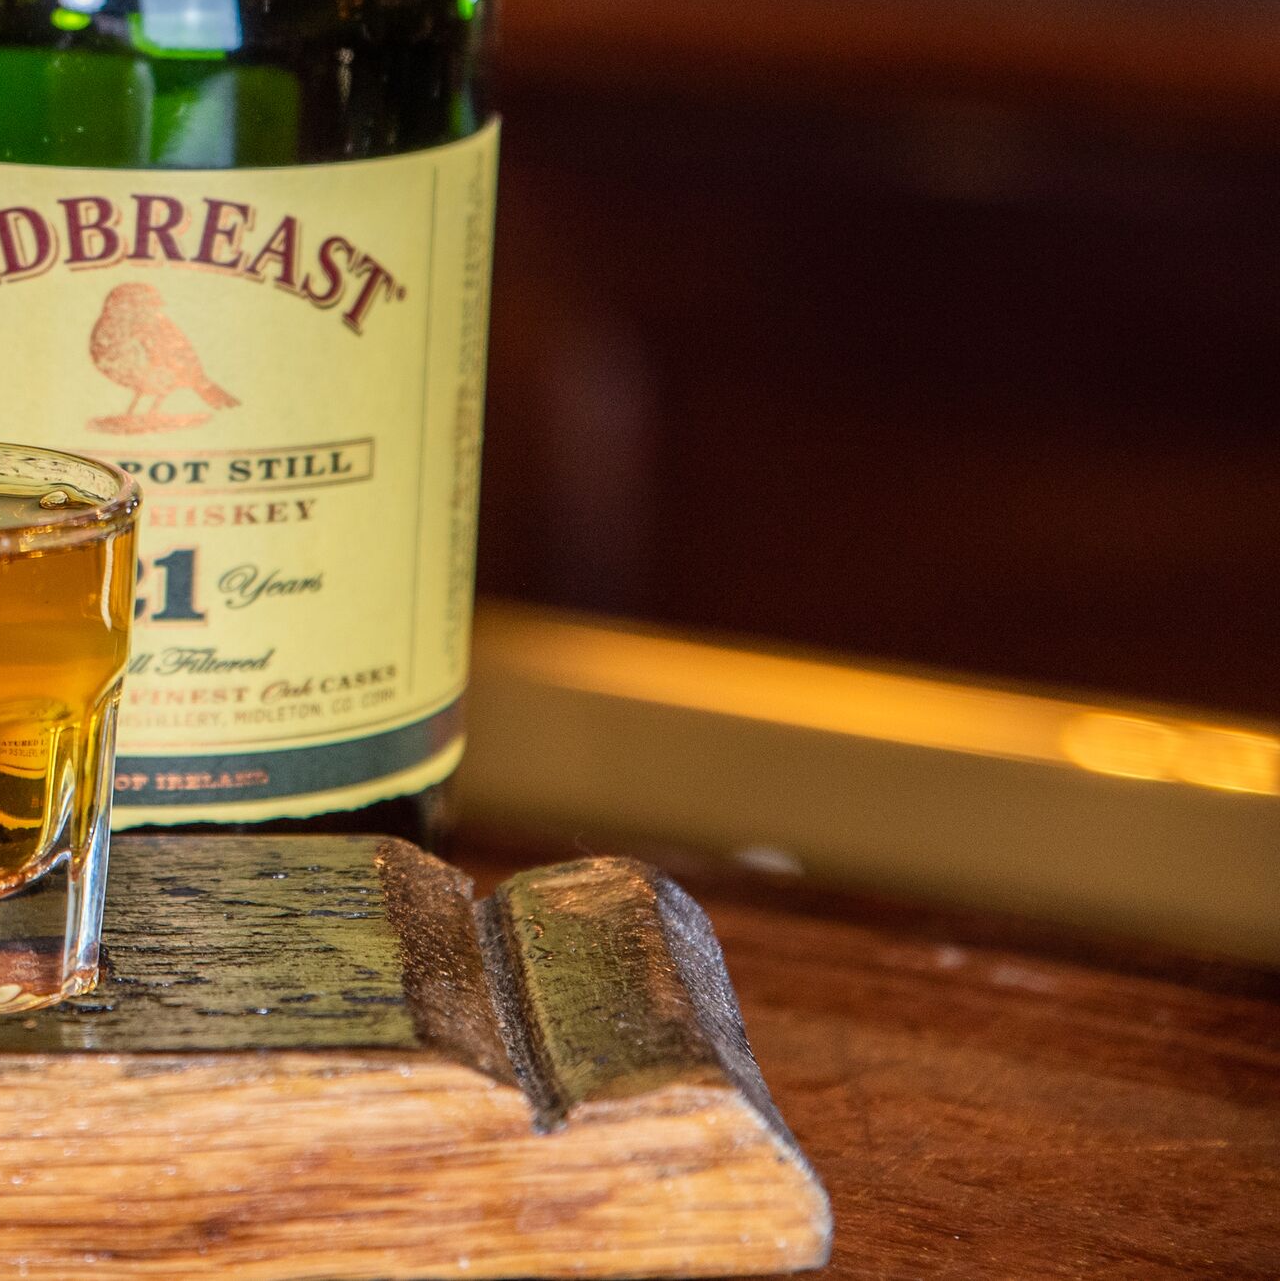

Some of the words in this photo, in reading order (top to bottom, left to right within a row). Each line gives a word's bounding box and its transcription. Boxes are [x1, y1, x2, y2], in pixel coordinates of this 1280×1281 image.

[118, 460, 210, 485] POT
[227, 450, 354, 483] STILL
[149, 498, 318, 528] HISKEY
[217, 564, 326, 610] Years
[155, 647, 275, 675] Filtered
[128, 686, 251, 707] FINEST
[320, 664, 397, 694] CASKS
[114, 773, 149, 792] OF
